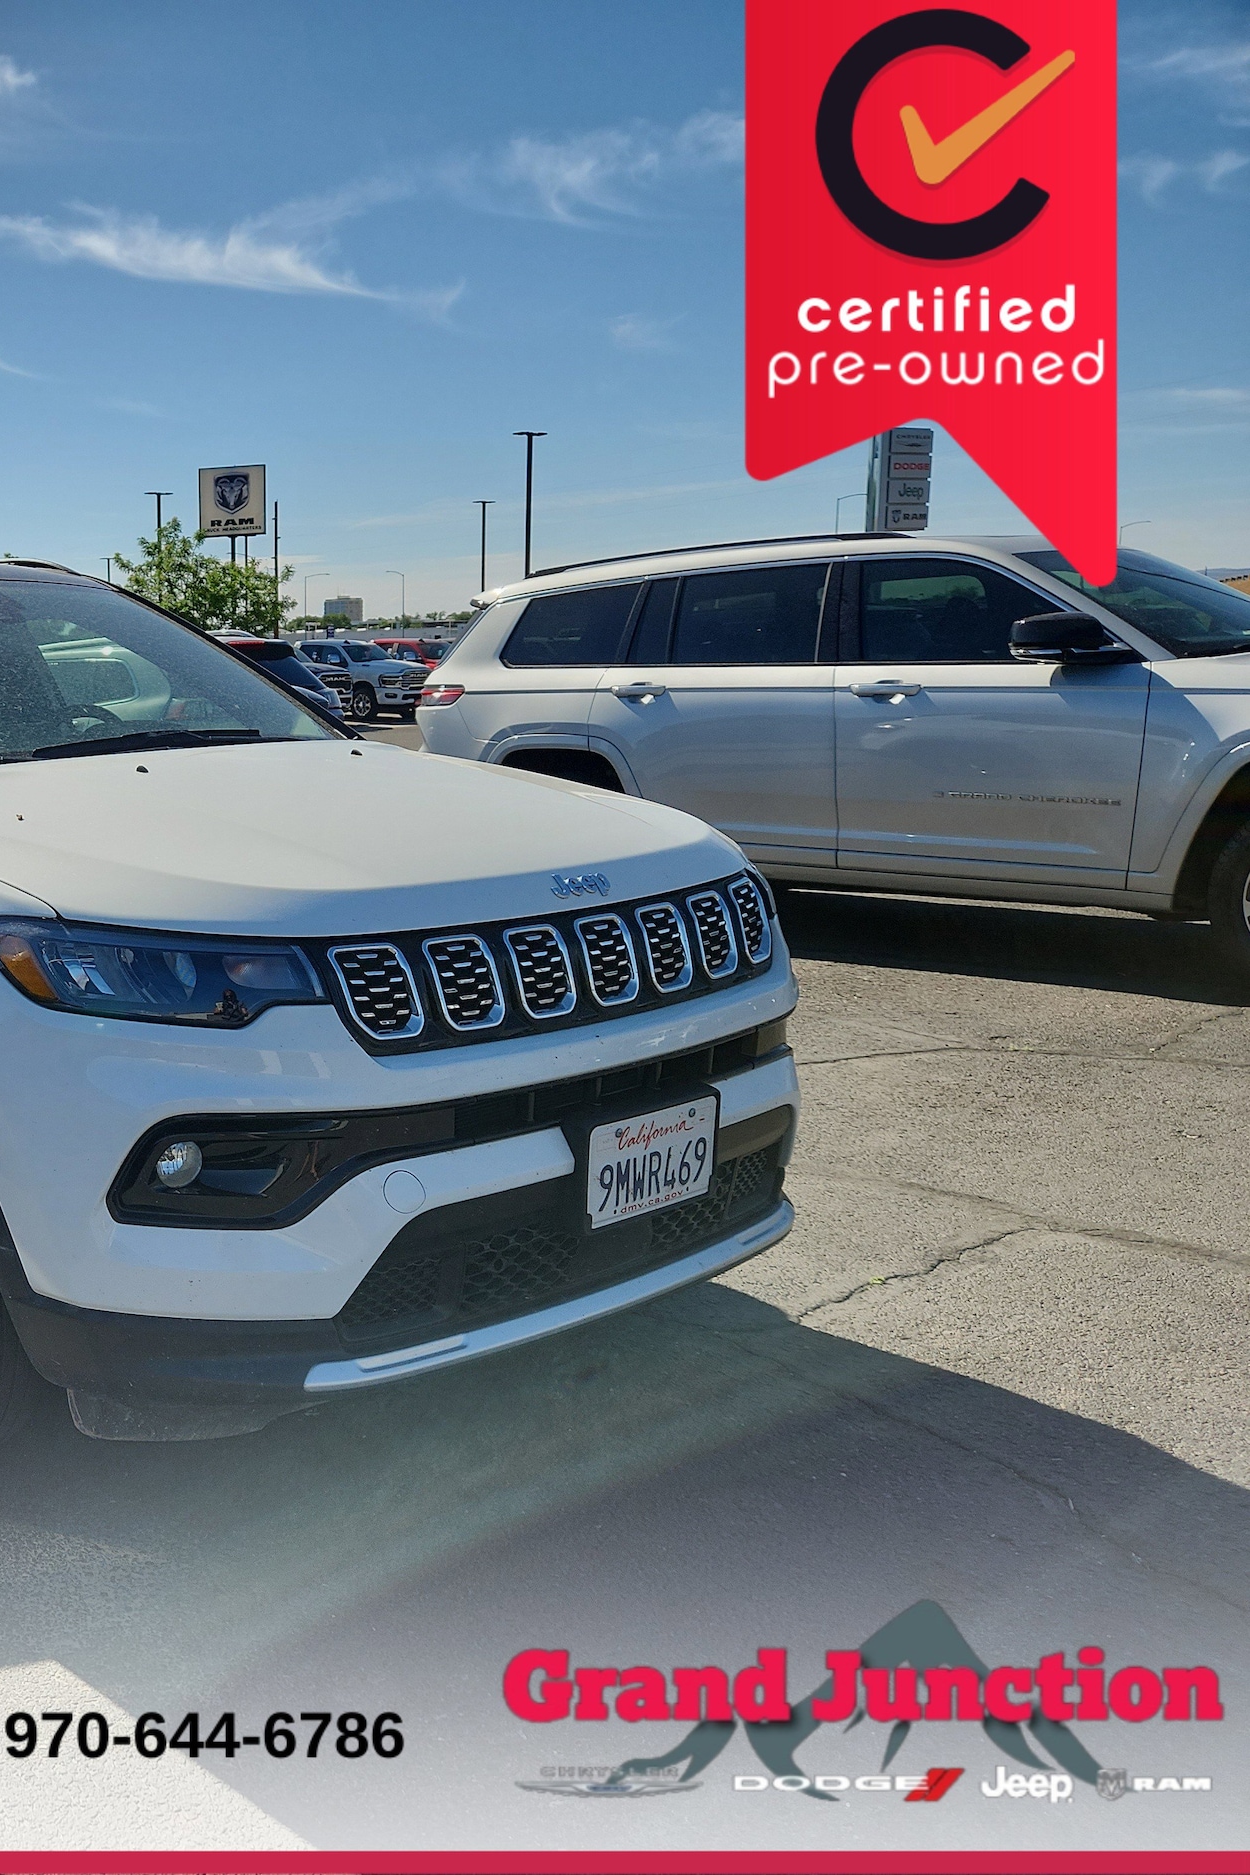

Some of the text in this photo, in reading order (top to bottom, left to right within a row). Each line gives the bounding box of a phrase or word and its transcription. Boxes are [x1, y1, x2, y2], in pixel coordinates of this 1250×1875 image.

[893, 462, 930, 471] DODGE
[898, 482, 924, 500] Jeep
[210, 517, 255, 527] RAM
[902, 513, 927, 521] RAM
[948, 790, 1013, 801] GRAND
[550, 872, 611, 900] Jeep
[618, 1118, 695, 1151] California
[598, 1136, 707, 1213] 9MWR469
[620, 1188, 684, 1214] dmv.ca.gov
